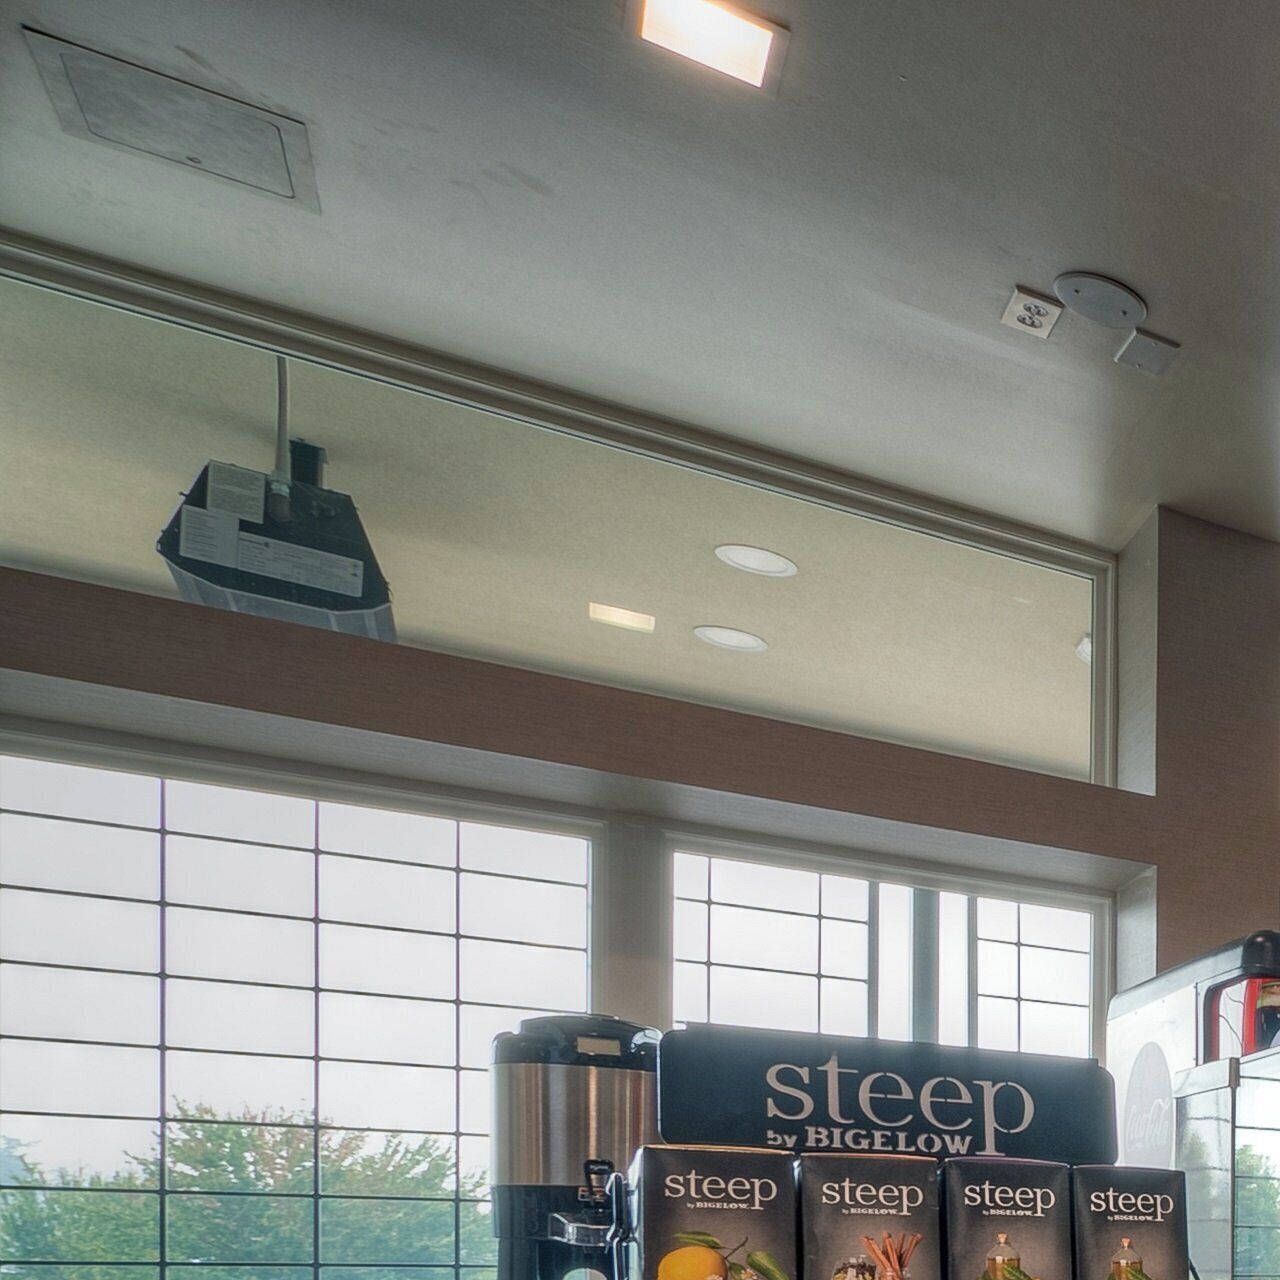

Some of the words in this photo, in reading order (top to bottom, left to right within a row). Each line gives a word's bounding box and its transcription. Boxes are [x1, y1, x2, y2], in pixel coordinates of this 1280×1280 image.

[766, 1051, 1035, 1157] steep
[767, 1129, 798, 1148] by
[805, 1126, 973, 1154] BIGELOW
[665, 1169, 777, 1210] steep
[696, 1202, 749, 1210] BIGELOW
[822, 1178, 924, 1216] steep
[964, 1180, 1056, 1217] steep
[1090, 1187, 1174, 1222] steep
